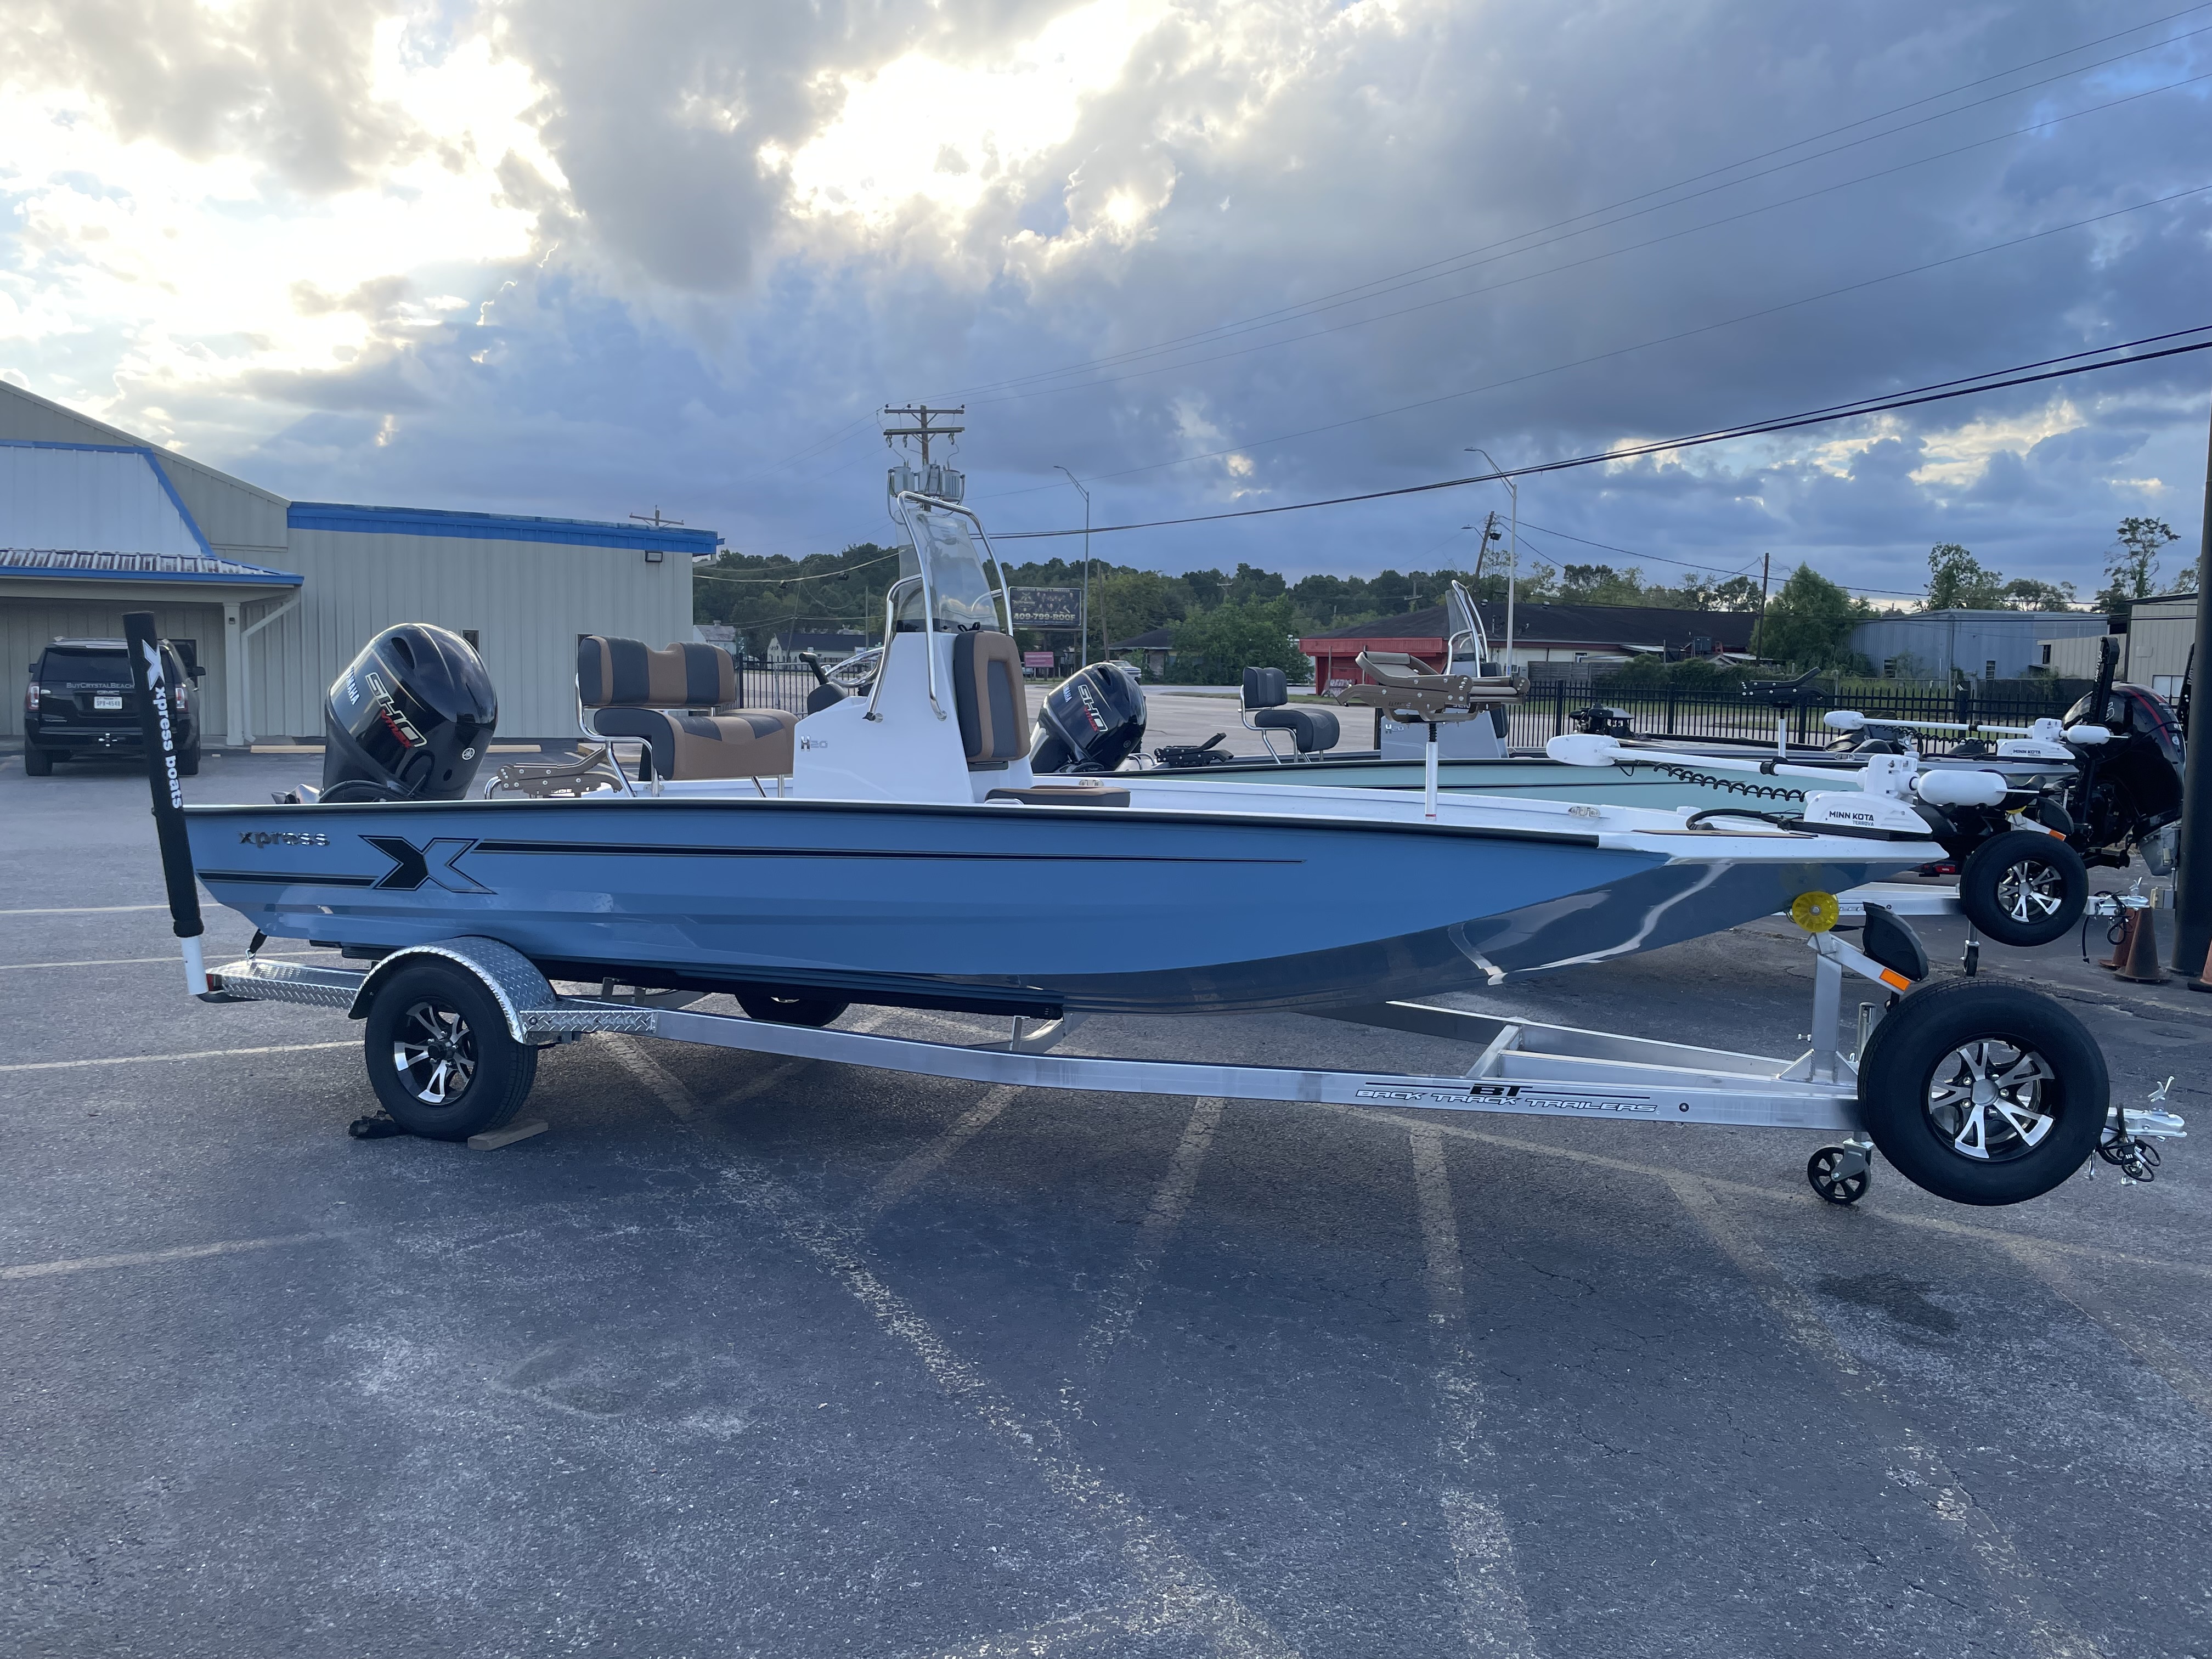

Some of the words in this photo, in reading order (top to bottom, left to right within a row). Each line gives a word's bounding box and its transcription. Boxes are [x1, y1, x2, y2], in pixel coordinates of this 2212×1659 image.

[1013, 613, 1076, 621] 409-799-ROOF
[153, 687, 173, 751] xpress
[166, 755, 183, 809] boats
[1829, 810, 1850, 819] MINN
[1852, 812, 1874, 821] KOTA
[238, 832, 330, 849] xpress
[1356, 1090, 1427, 1101] BACK
[1430, 1093, 1523, 1106] TRACK
[1525, 1098, 1658, 1113] TRAILERS
